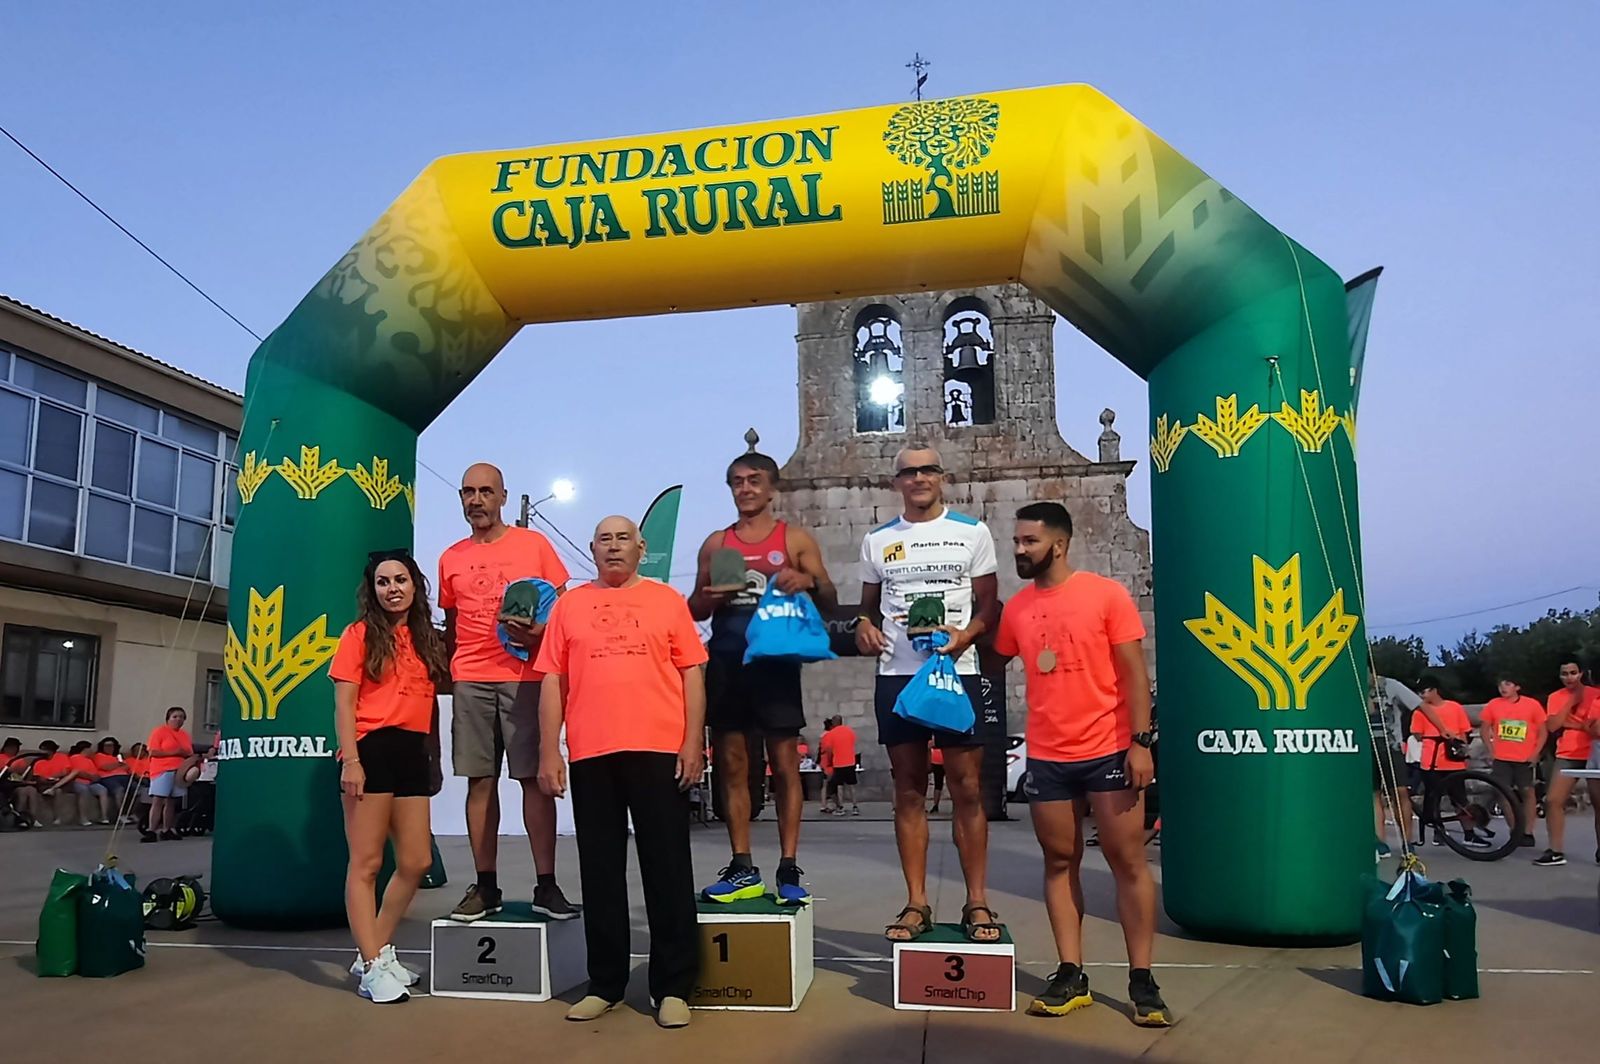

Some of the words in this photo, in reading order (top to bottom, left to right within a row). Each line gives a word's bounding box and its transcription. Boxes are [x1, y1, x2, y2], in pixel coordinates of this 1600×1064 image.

[491, 125, 840, 194] FUNDACION
[491, 194, 631, 250] CAJA
[641, 172, 843, 239] RURAL
[1197, 729, 1268, 755] CAJA
[1273, 729, 1359, 754] RURAL
[1502, 725, 1521, 736] 167
[218, 738, 244, 760] AJA
[248, 736, 333, 758] RURAL
[477, 936, 497, 964] 2
[712, 933, 729, 963] 1
[462, 972, 513, 988] SmartChip
[944, 955, 965, 982] 3
[924, 985, 986, 1002] SmartChip
